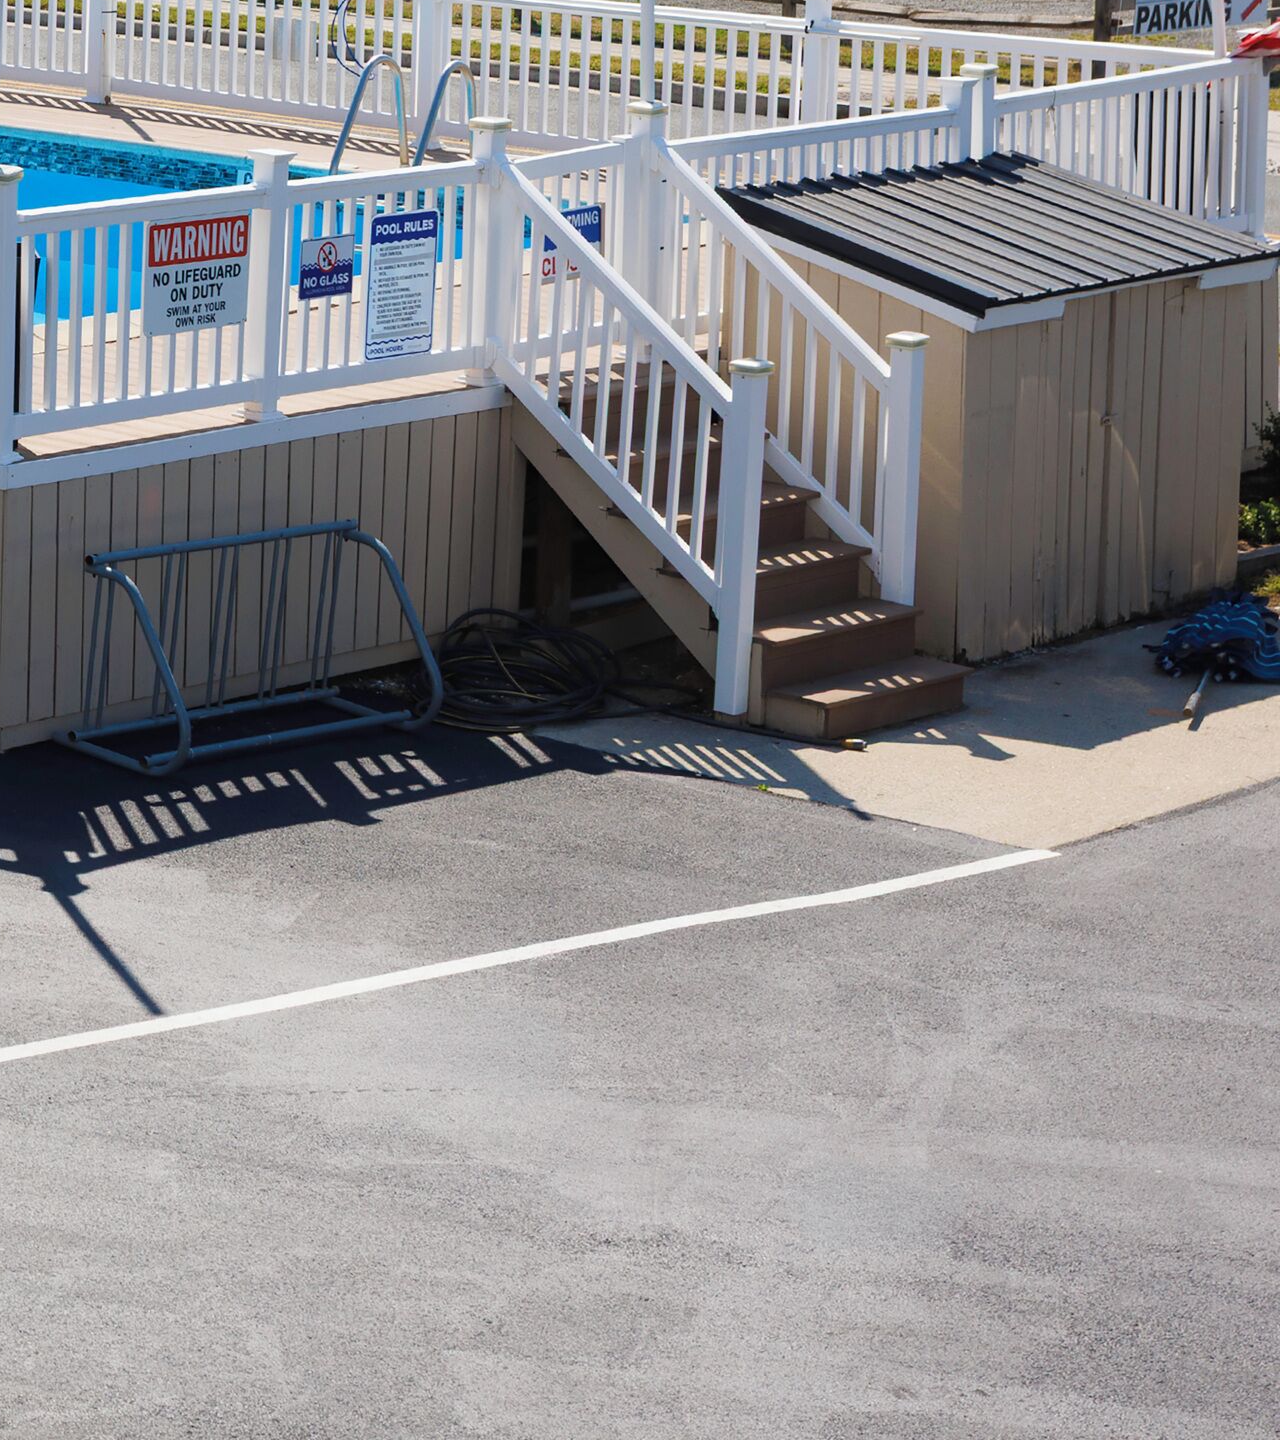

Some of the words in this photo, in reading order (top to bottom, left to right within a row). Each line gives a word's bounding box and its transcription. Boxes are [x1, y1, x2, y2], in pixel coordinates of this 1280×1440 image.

[375, 223, 402, 237] POOL
[404, 219, 434, 233] RULES
[153, 220, 245, 263] WARNING
[153, 272, 170, 287] NO
[175, 263, 242, 285] LIFEGUARD
[303, 276, 318, 289] NO
[319, 272, 349, 287] GLASS
[170, 287, 187, 302] ON
[192, 283, 223, 300] DUTY
[166, 305, 190, 318] SWIM
[192, 303, 202, 314] AT
[205, 301, 226, 313] YOUR
[175, 316, 194, 328] OWN
[197, 313, 216, 325] RISK
